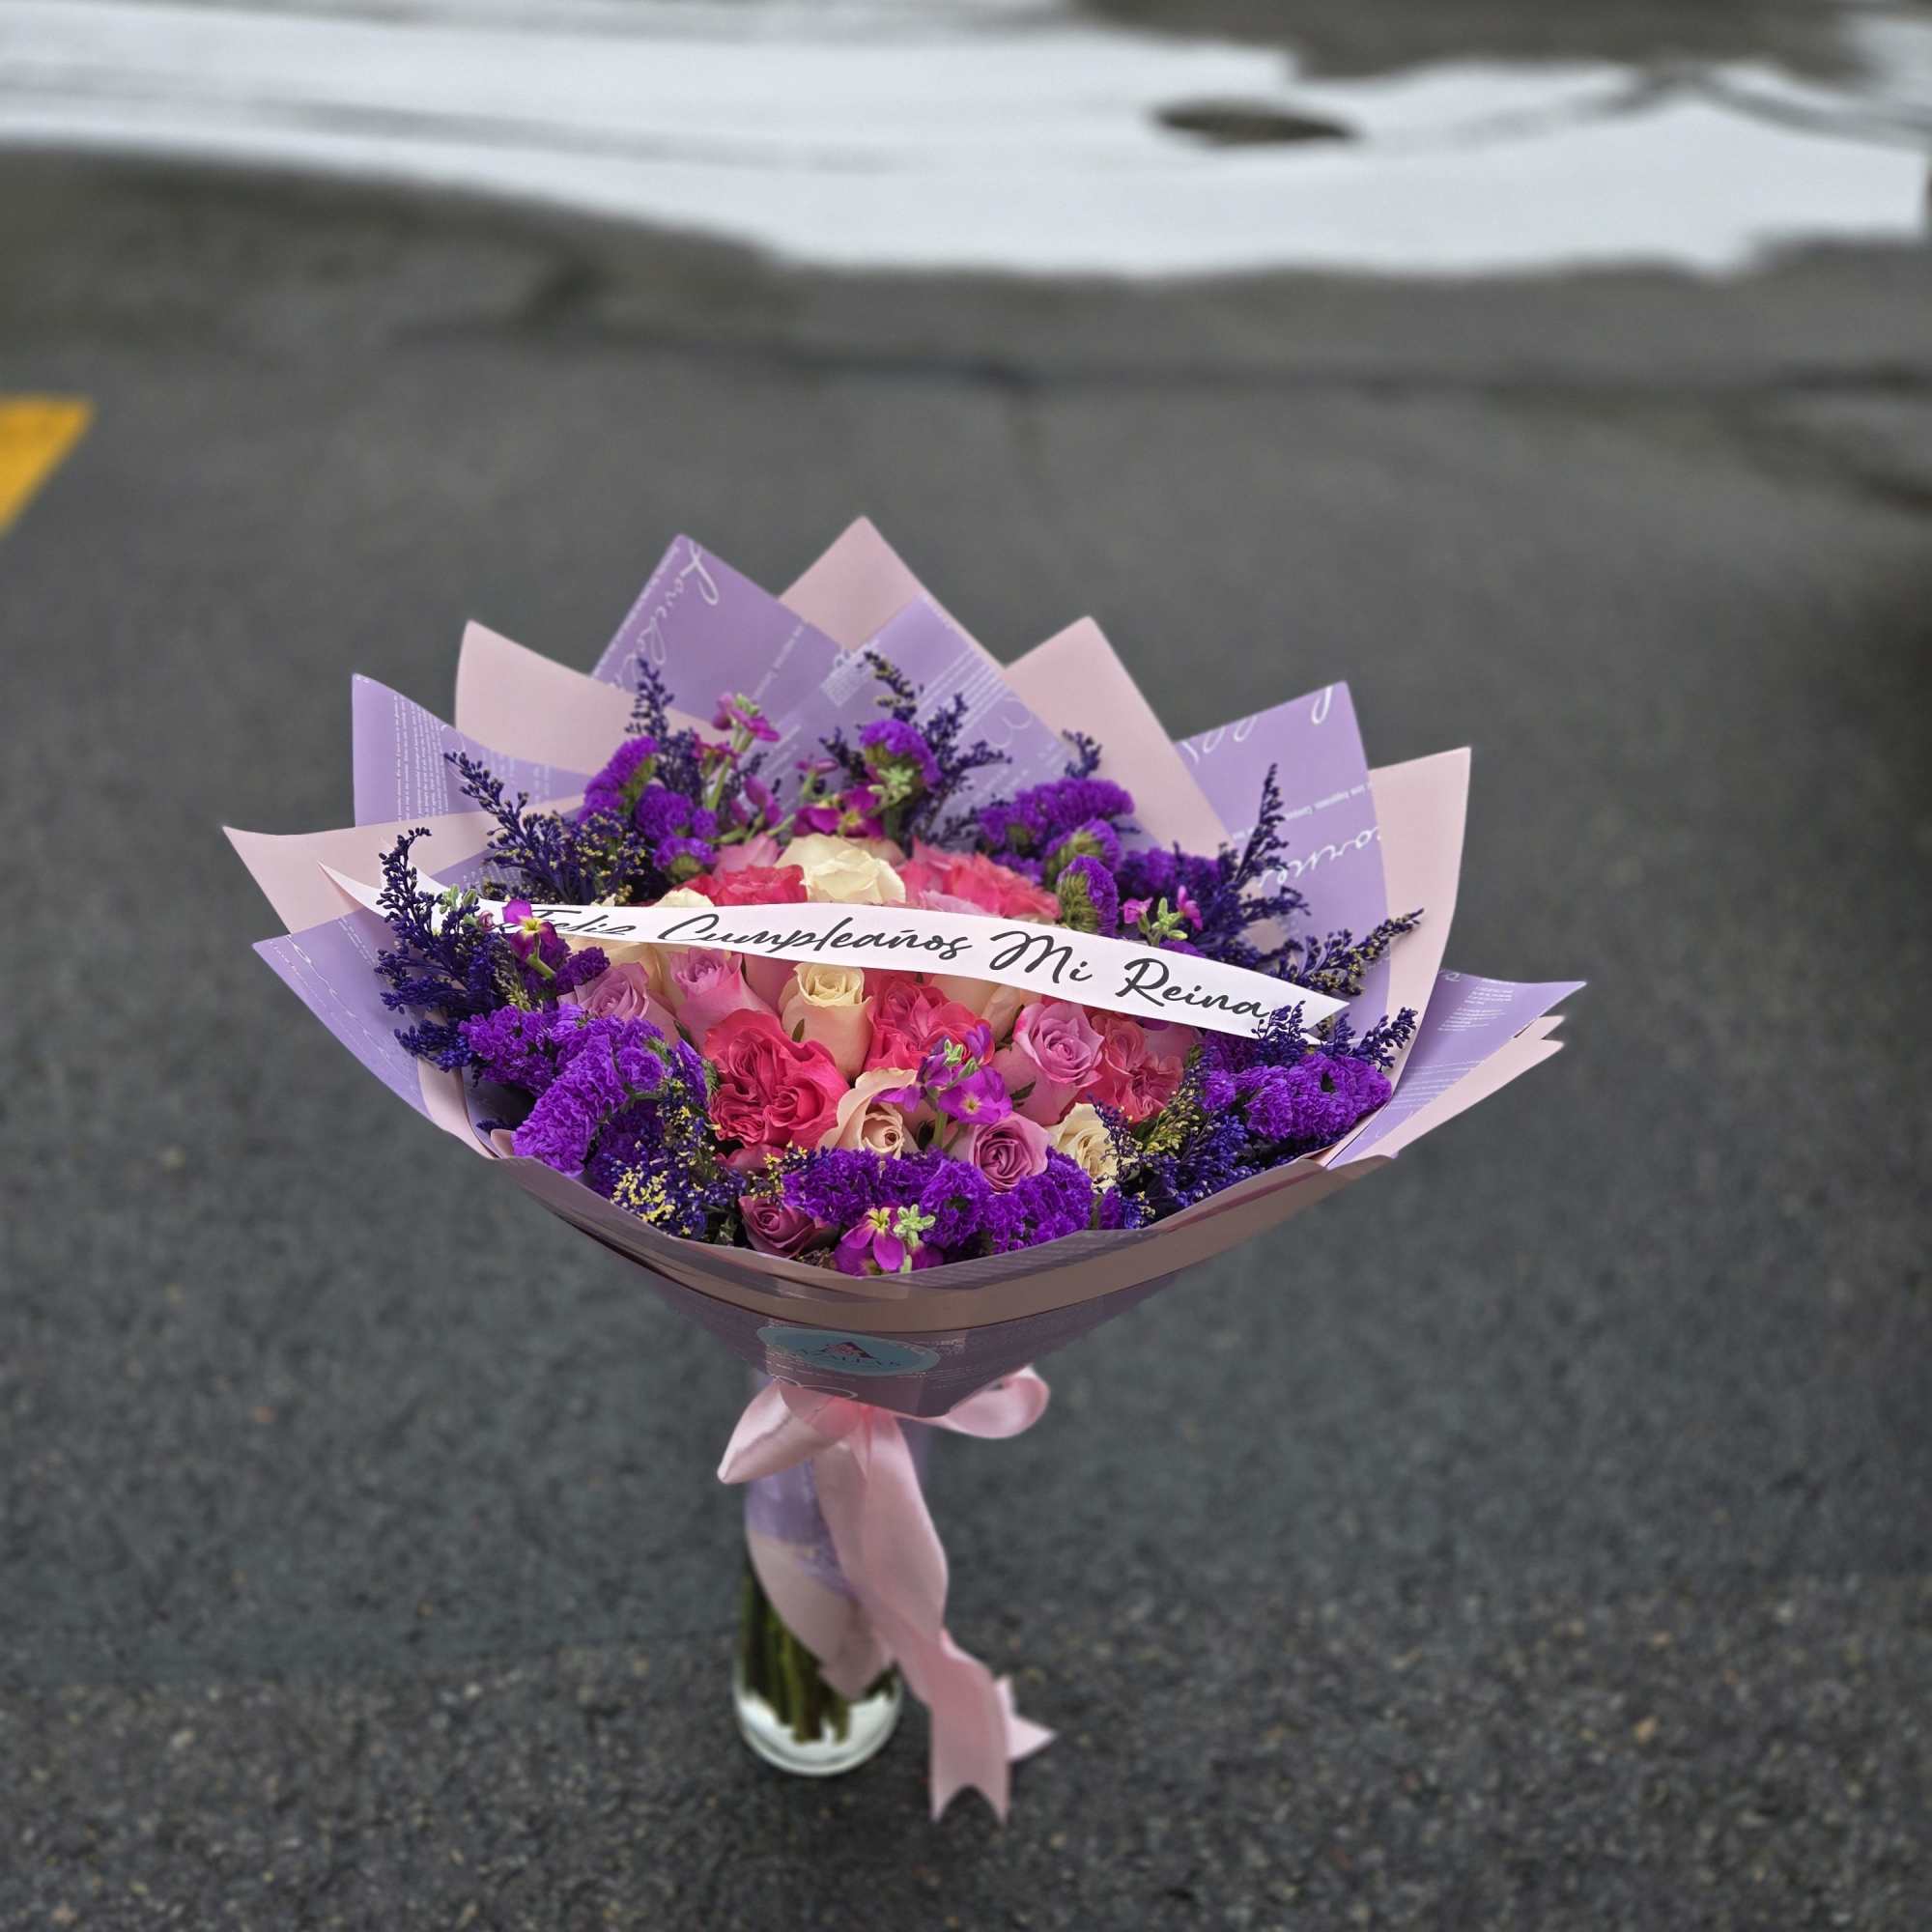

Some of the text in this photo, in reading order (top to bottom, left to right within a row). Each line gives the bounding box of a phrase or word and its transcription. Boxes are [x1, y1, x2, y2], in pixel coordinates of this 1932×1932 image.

[495, 909, 1271, 1018] Feliz Cumpleaños Mi Reina
